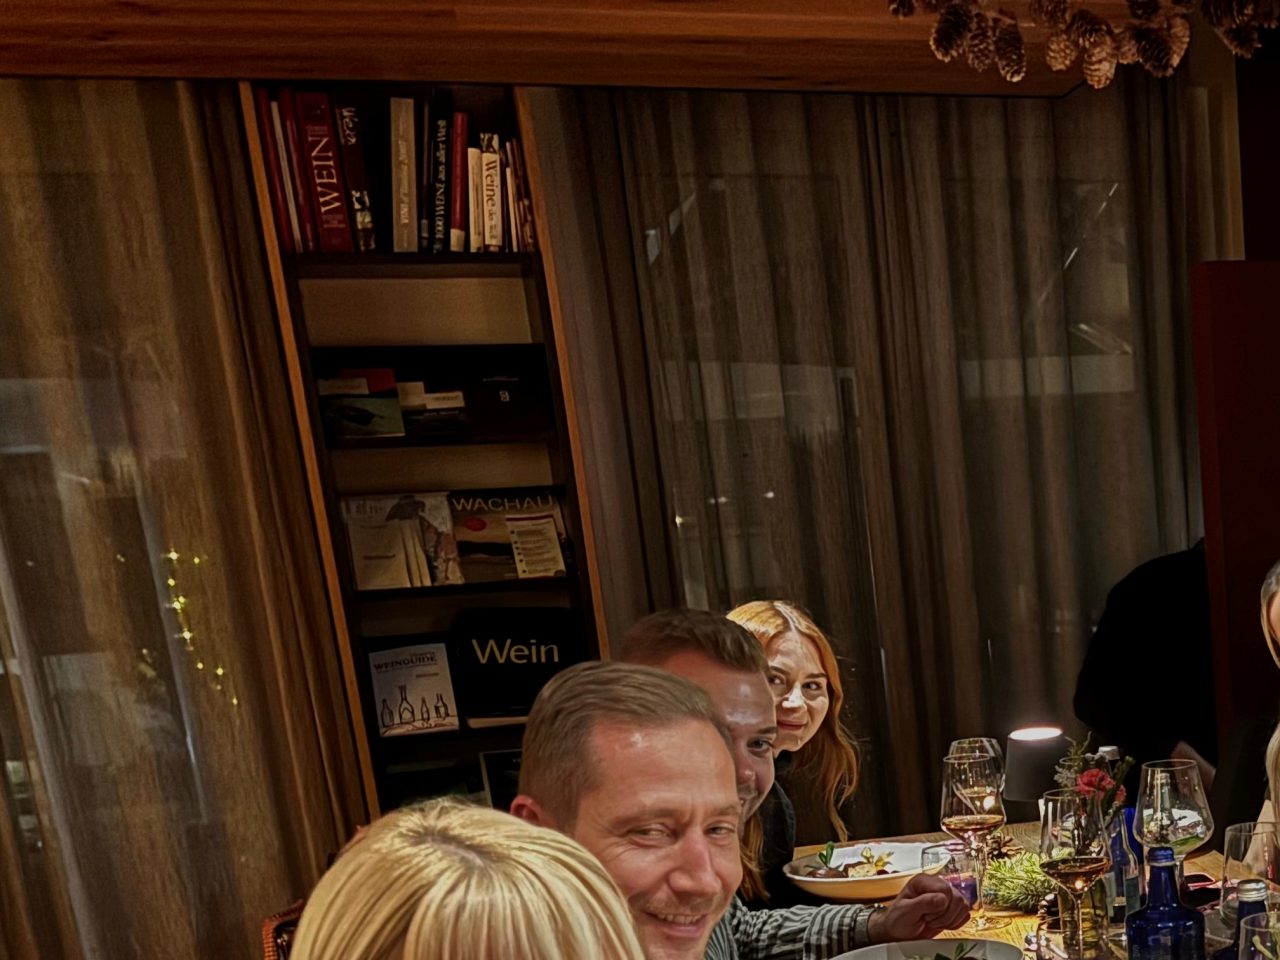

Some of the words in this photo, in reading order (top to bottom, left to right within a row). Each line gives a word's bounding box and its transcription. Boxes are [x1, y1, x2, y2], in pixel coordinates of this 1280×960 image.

[309, 136, 342, 213] WEIN
[485, 159, 498, 208] Weine
[451, 494, 554, 512] WACHAU
[373, 654, 438, 671] WEINGUIDE
[472, 638, 559, 665] Wein
